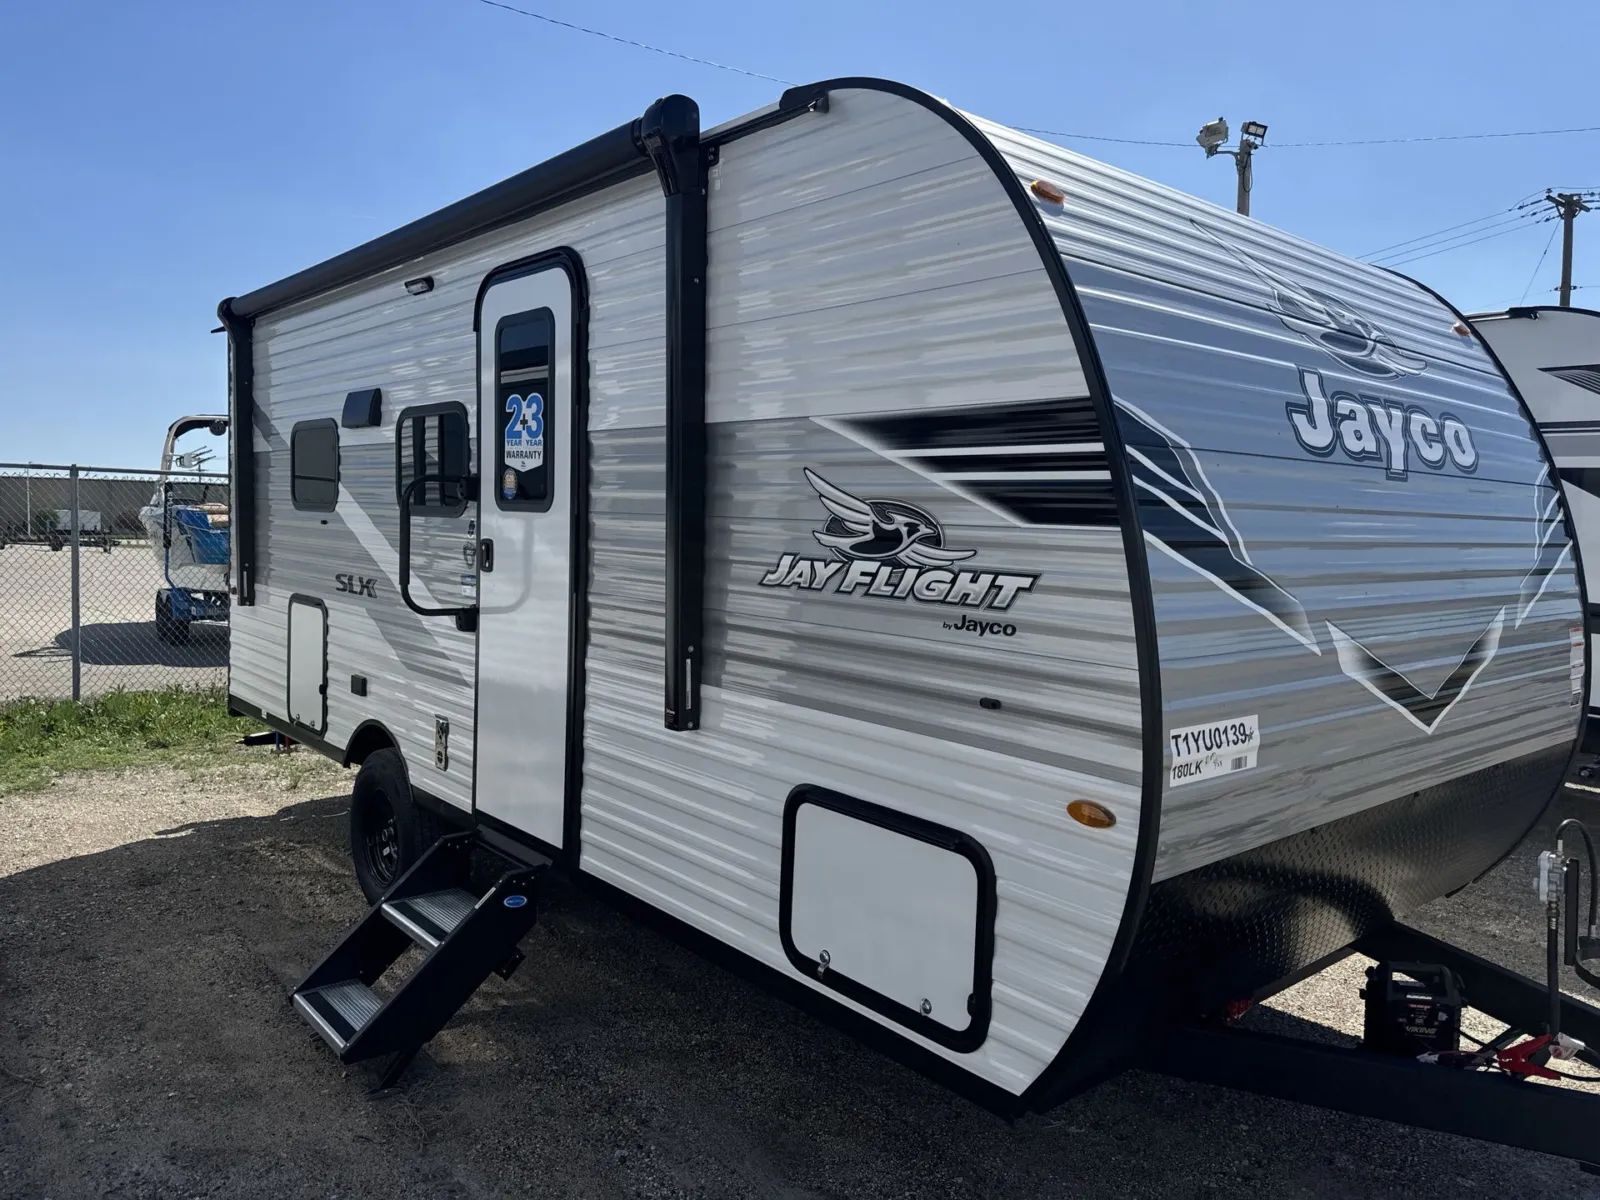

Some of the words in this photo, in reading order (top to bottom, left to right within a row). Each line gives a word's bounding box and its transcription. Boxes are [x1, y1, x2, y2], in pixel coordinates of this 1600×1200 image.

[1286, 366, 1479, 481] Jayco
[506, 450, 542, 460] WARRANTY
[507, 439, 522, 447] YEAR
[526, 439, 543, 447] YEAR
[335, 573, 378, 599] SLK
[759, 552, 844, 590] JAY
[836, 560, 1041, 611] FLIGHT
[943, 621, 953, 631] by
[954, 615, 1017, 637] Jayco
[1171, 722, 1248, 757] T1YU0139
[1172, 760, 1204, 780] 180LK
